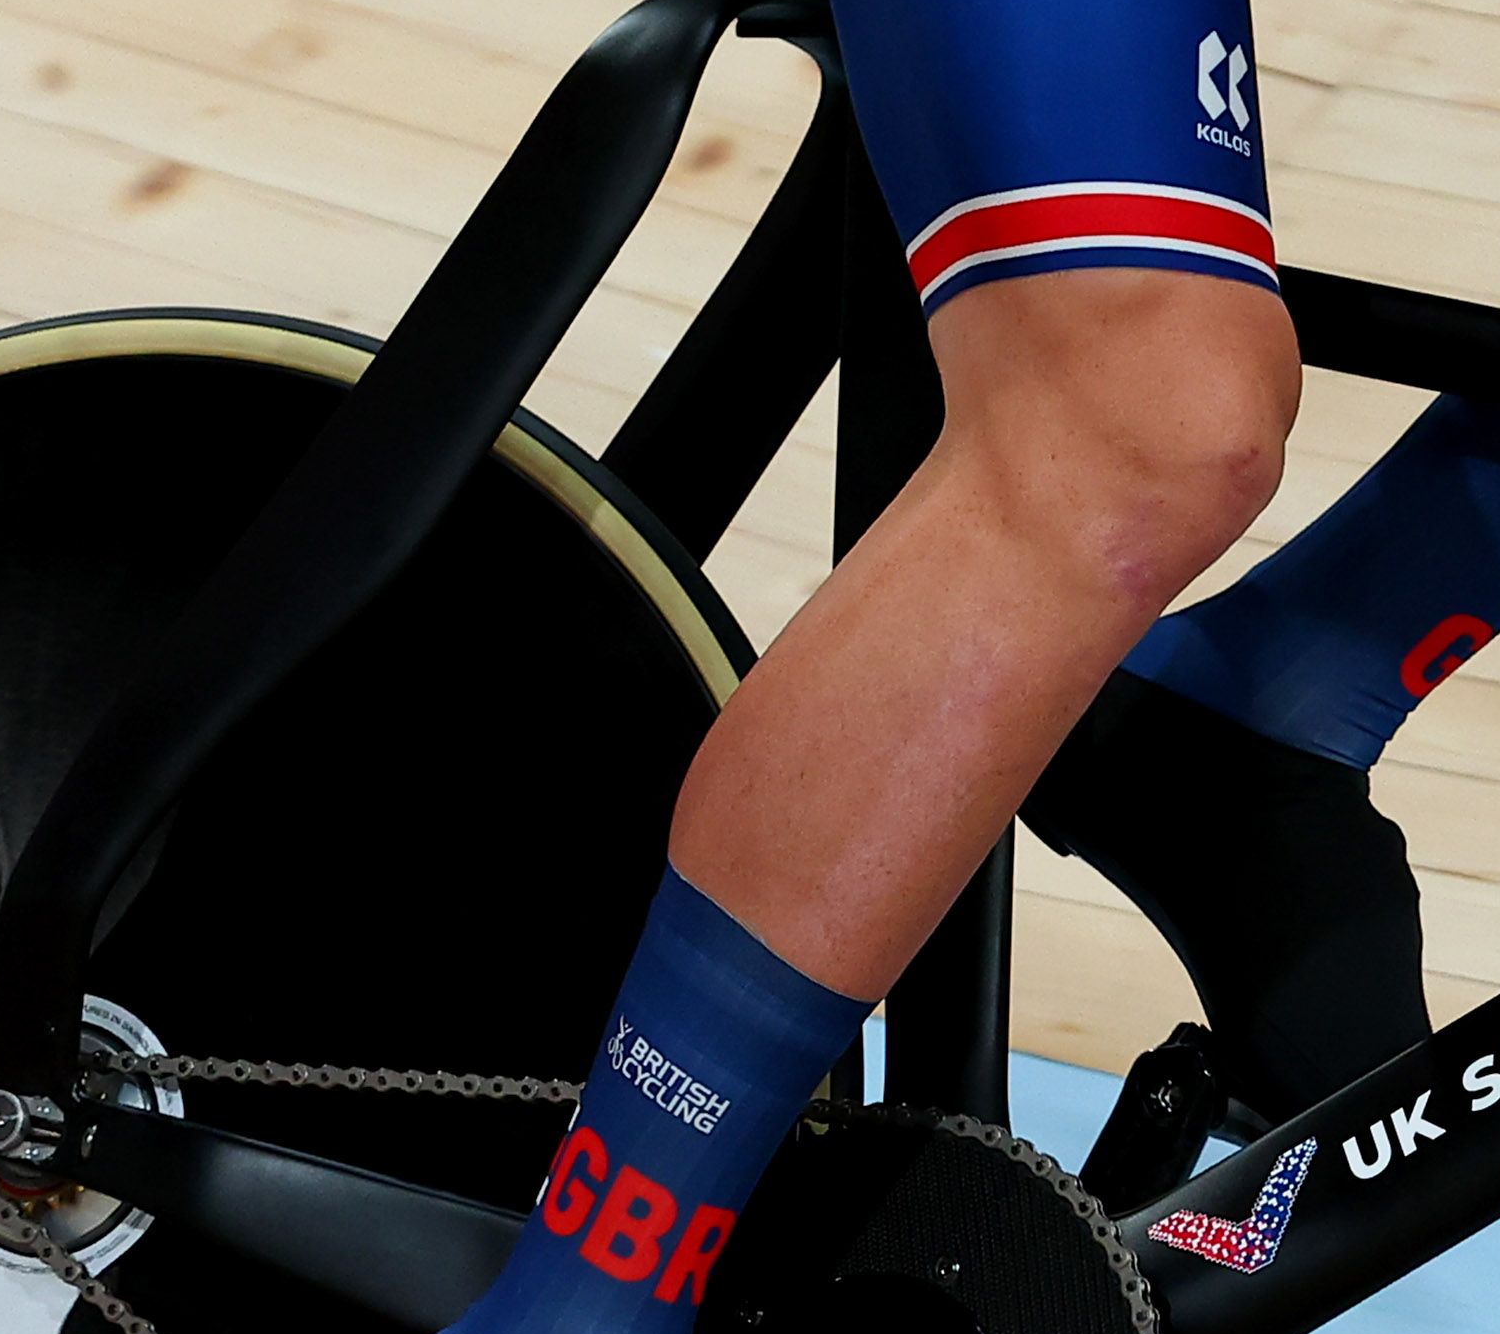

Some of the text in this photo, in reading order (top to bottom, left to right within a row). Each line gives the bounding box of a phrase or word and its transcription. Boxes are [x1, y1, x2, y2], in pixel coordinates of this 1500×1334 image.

[622, 1057, 718, 1134] CYCLING
[630, 1036, 730, 1117] BRITISH
[1342, 1090, 1446, 1180] UK
[543, 1126, 738, 1307] GBR
